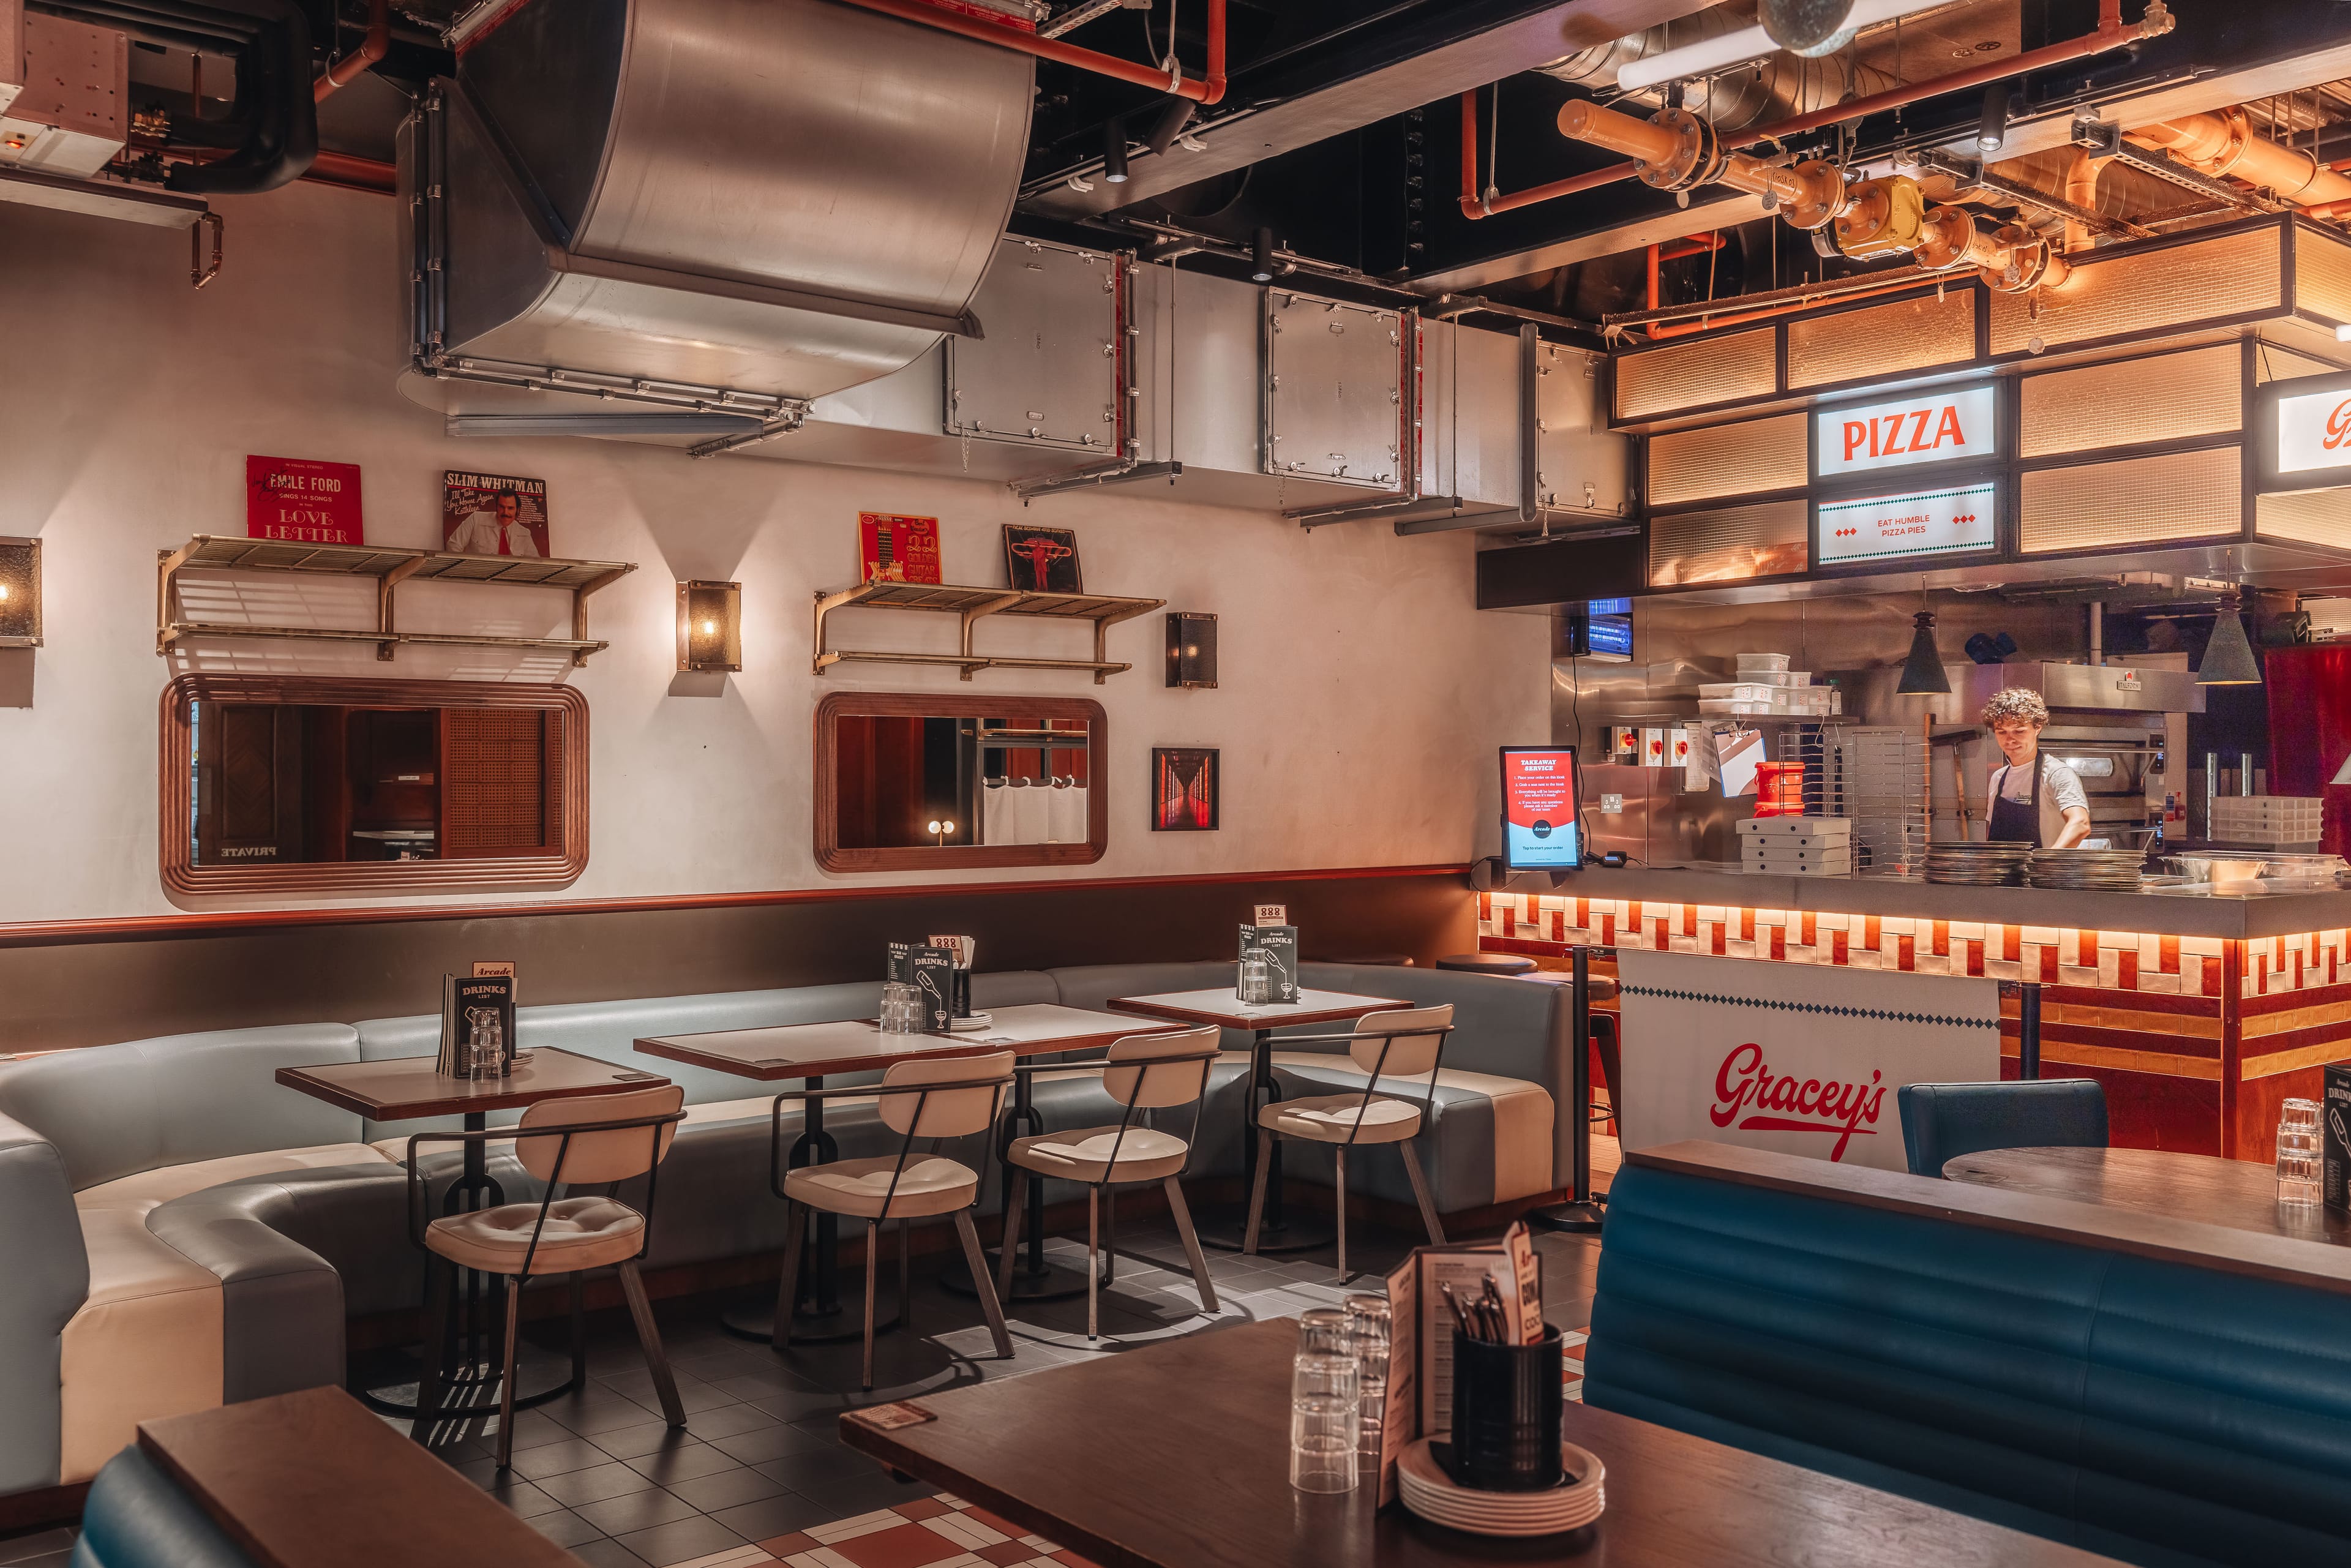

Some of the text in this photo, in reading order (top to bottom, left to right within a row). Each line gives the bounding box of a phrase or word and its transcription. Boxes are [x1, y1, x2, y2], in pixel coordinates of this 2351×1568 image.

[1843, 405, 1965, 461] PIZZA
[270, 473, 305, 489] EMILE
[311, 477, 341, 492] FORD
[447, 473, 544, 494] SLIM WHITMAN
[461, 488, 475, 497] Take
[447, 493, 494, 511] You Home Again
[455, 505, 480, 516] Kathleen
[279, 509, 333, 525] LOVE
[1878, 515, 1930, 527] EAT HUMBLE
[264, 525, 348, 543] LETTER
[1882, 526, 1925, 537] PIZZA PIES
[907, 535, 937, 553] 22
[907, 553, 937, 564] GOLDEN
[907, 564, 935, 575] GUITAR
[1261, 907, 1280, 916] 888
[936, 938, 956, 948] 888
[915, 958, 948, 966] DRINKS
[462, 985, 507, 996] DRINKS
[2328, 1087, 2351, 1103] DRIN
[1709, 1043, 1887, 1163] Gracey's
